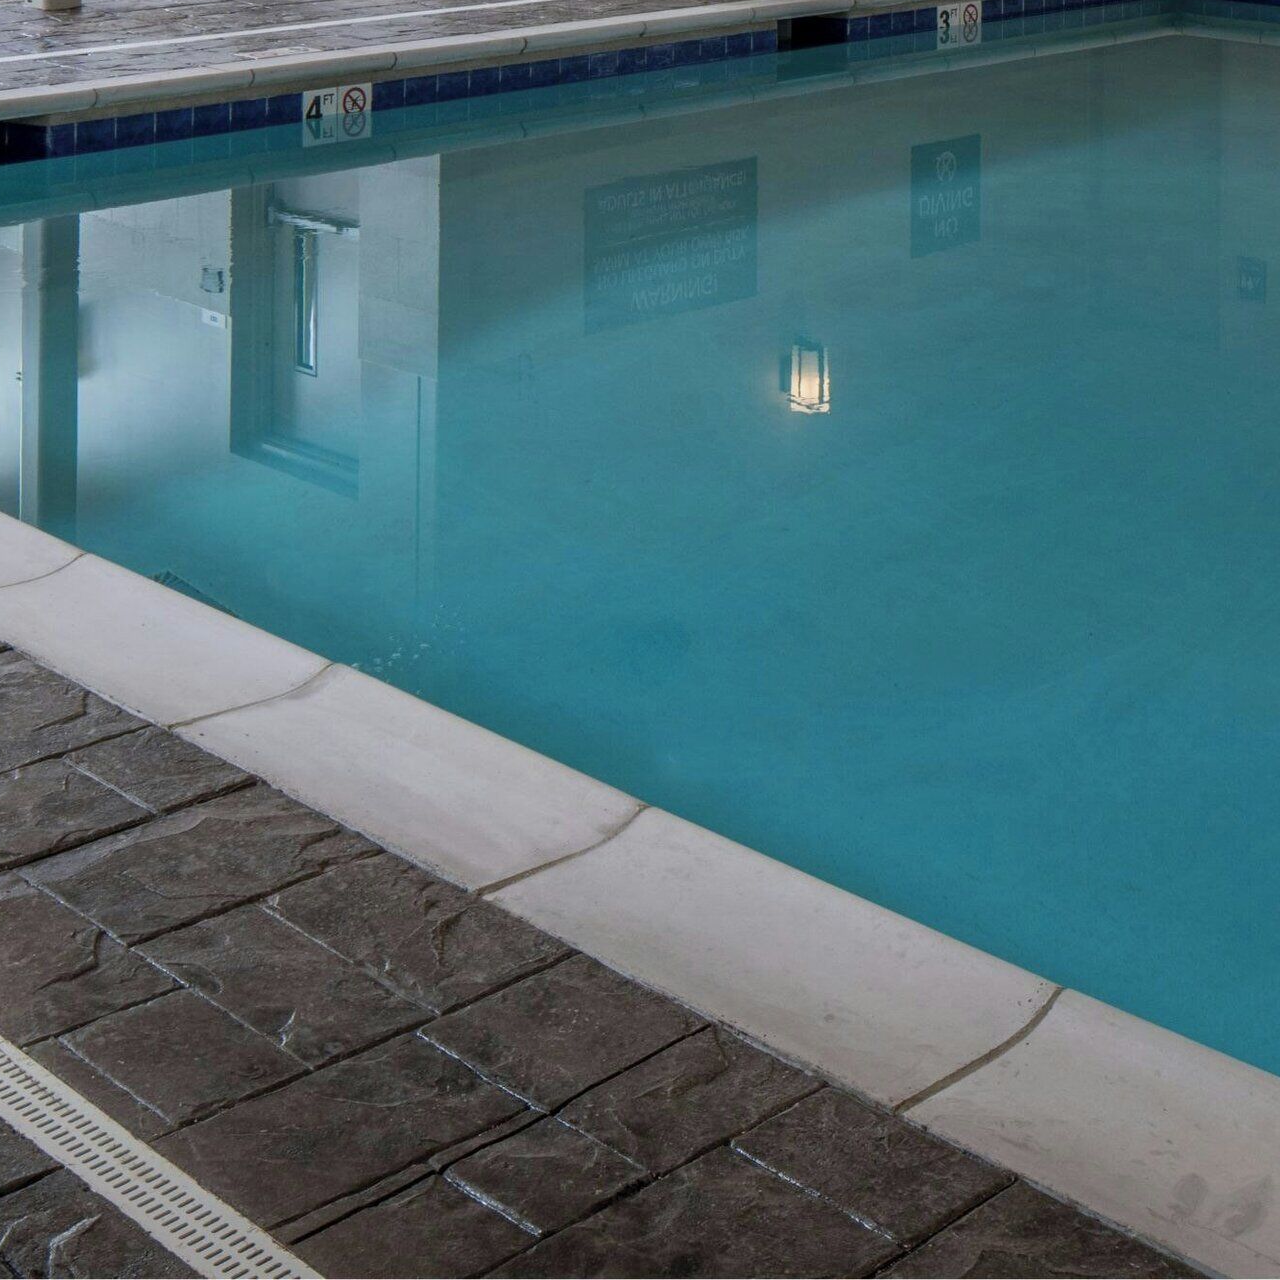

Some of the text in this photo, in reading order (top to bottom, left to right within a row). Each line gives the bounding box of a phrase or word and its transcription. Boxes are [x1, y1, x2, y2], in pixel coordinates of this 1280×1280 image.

[940, 10, 950, 29] 3
[306, 93, 335, 119] 4 FT
